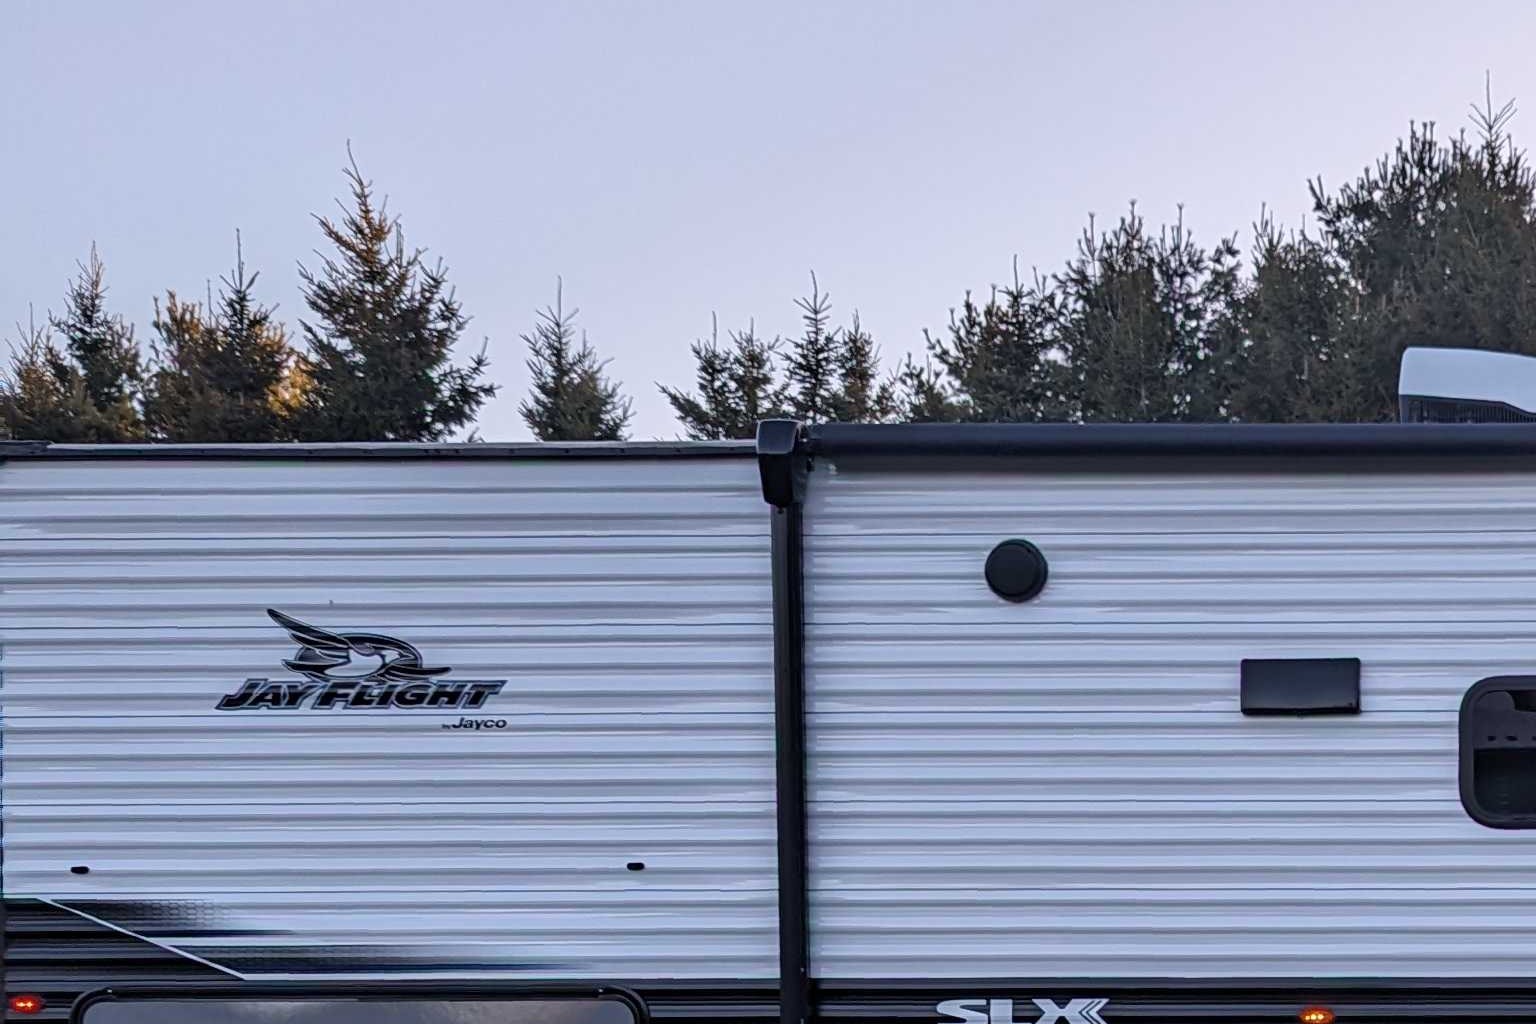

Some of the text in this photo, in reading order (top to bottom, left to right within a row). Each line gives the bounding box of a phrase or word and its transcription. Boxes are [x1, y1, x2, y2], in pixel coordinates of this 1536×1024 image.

[215, 678, 508, 710] JAY FLIGHT
[451, 717, 508, 731] Jayco
